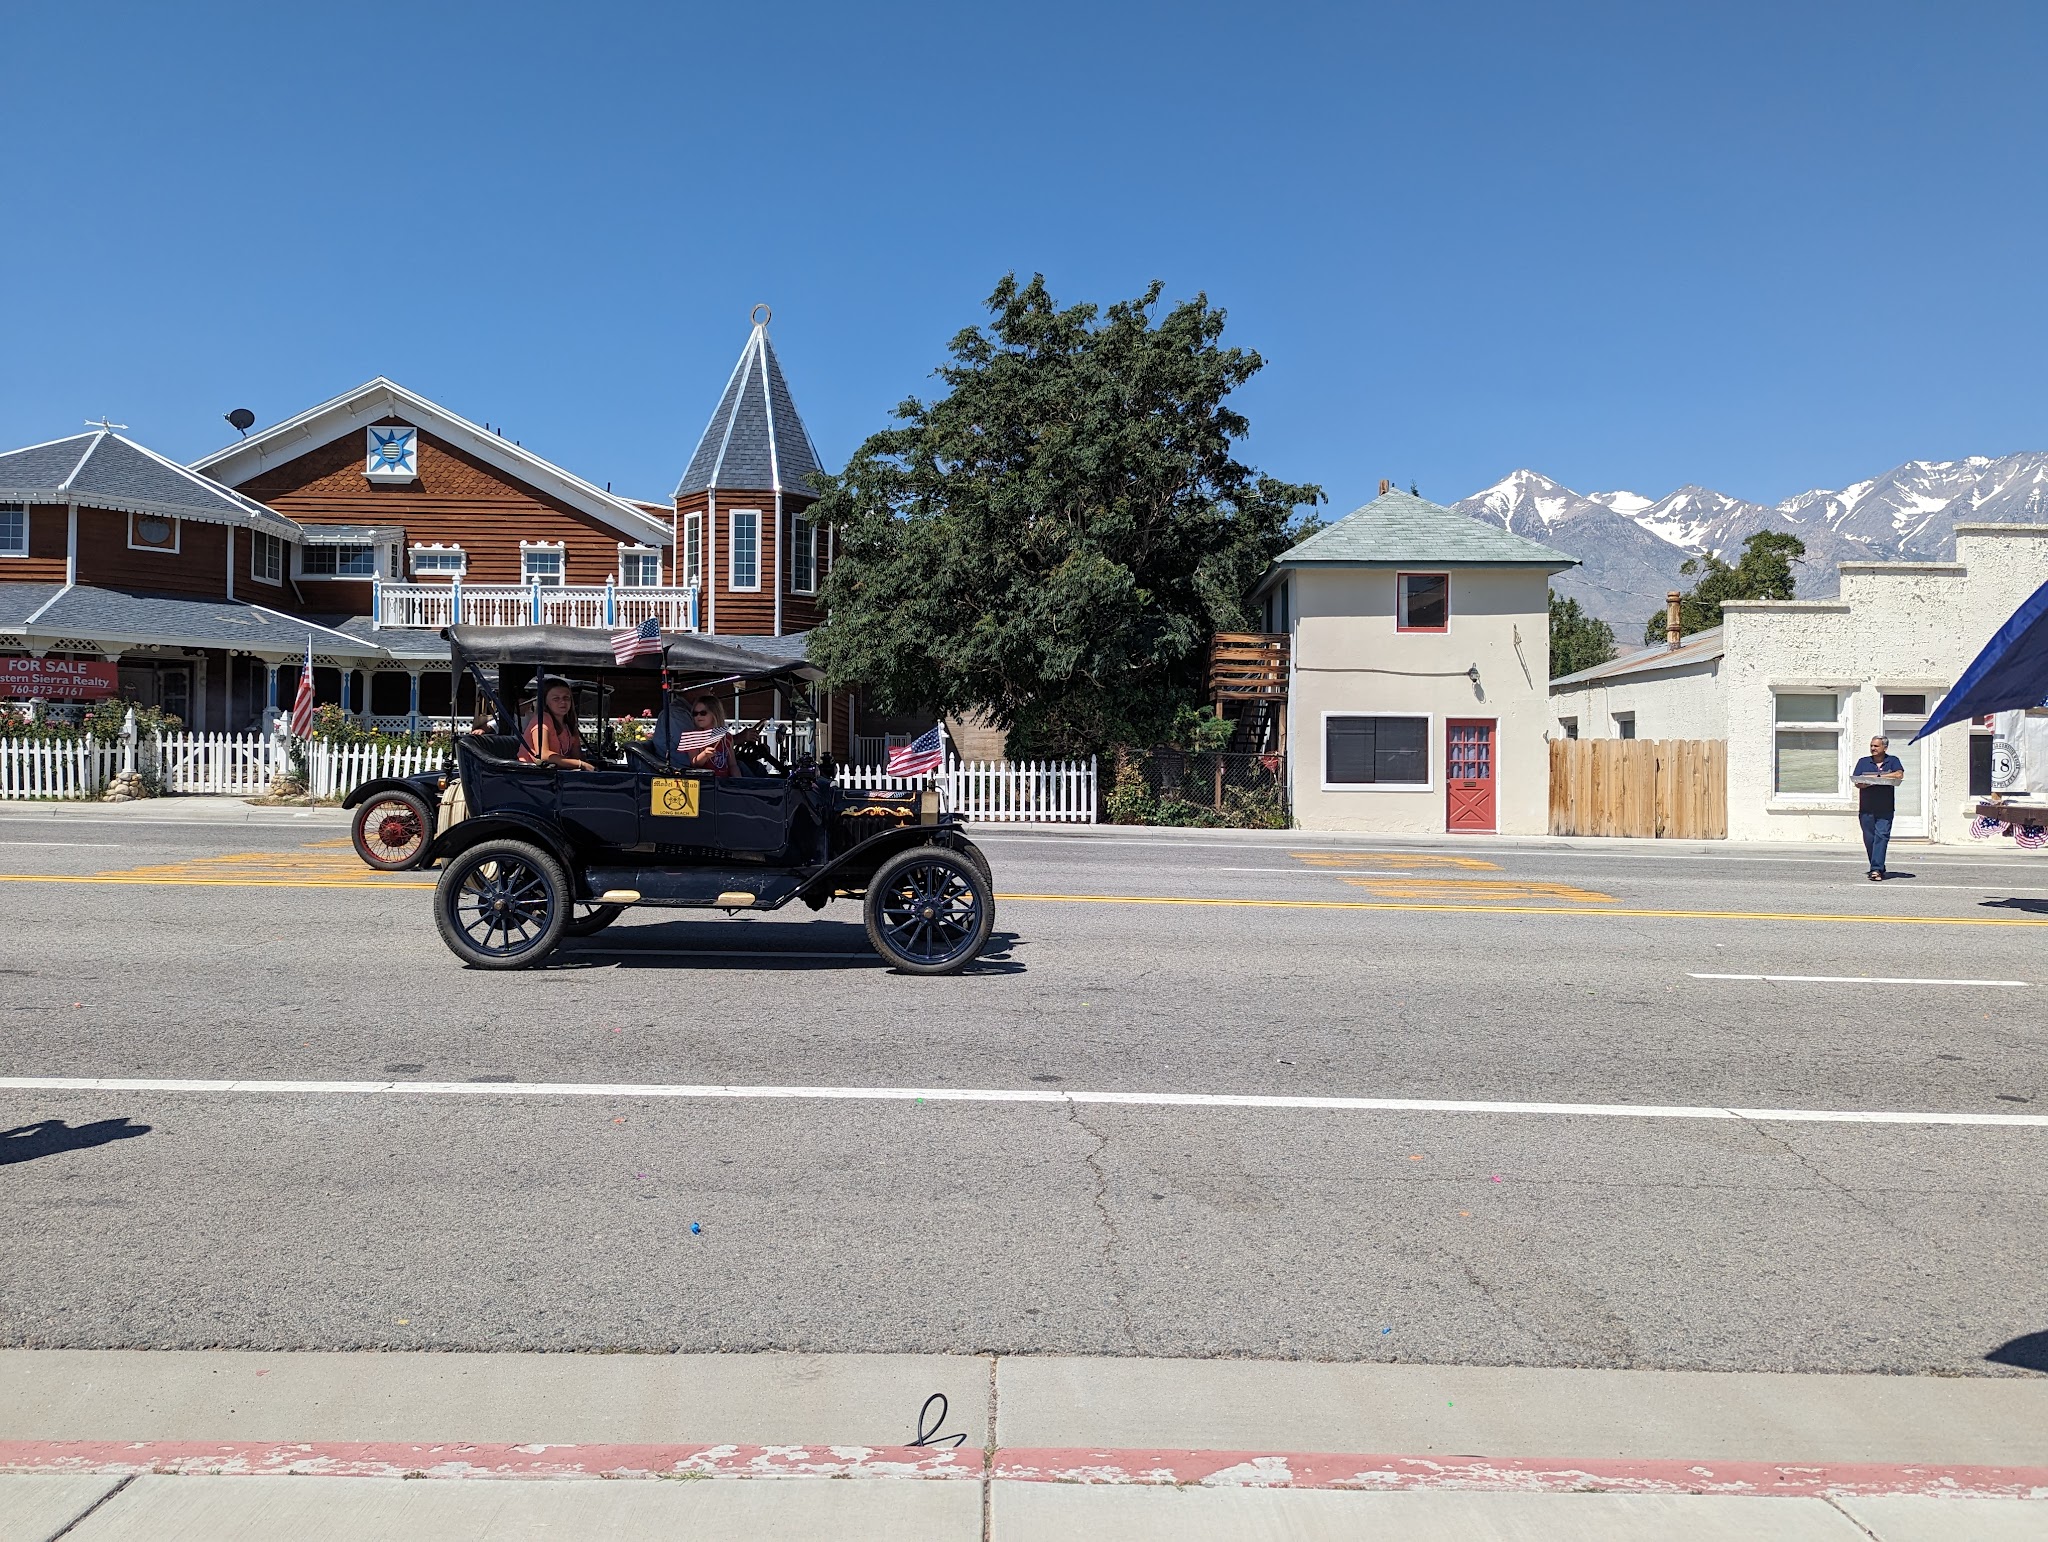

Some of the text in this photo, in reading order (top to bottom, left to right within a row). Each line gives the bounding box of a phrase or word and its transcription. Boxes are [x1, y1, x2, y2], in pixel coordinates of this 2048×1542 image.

[9, 660, 87, 674] FOR SALE
[32, 674, 69, 684] Sierra
[73, 676, 109, 688] Realty
[11, 685, 83, 696] 760-873-4161
